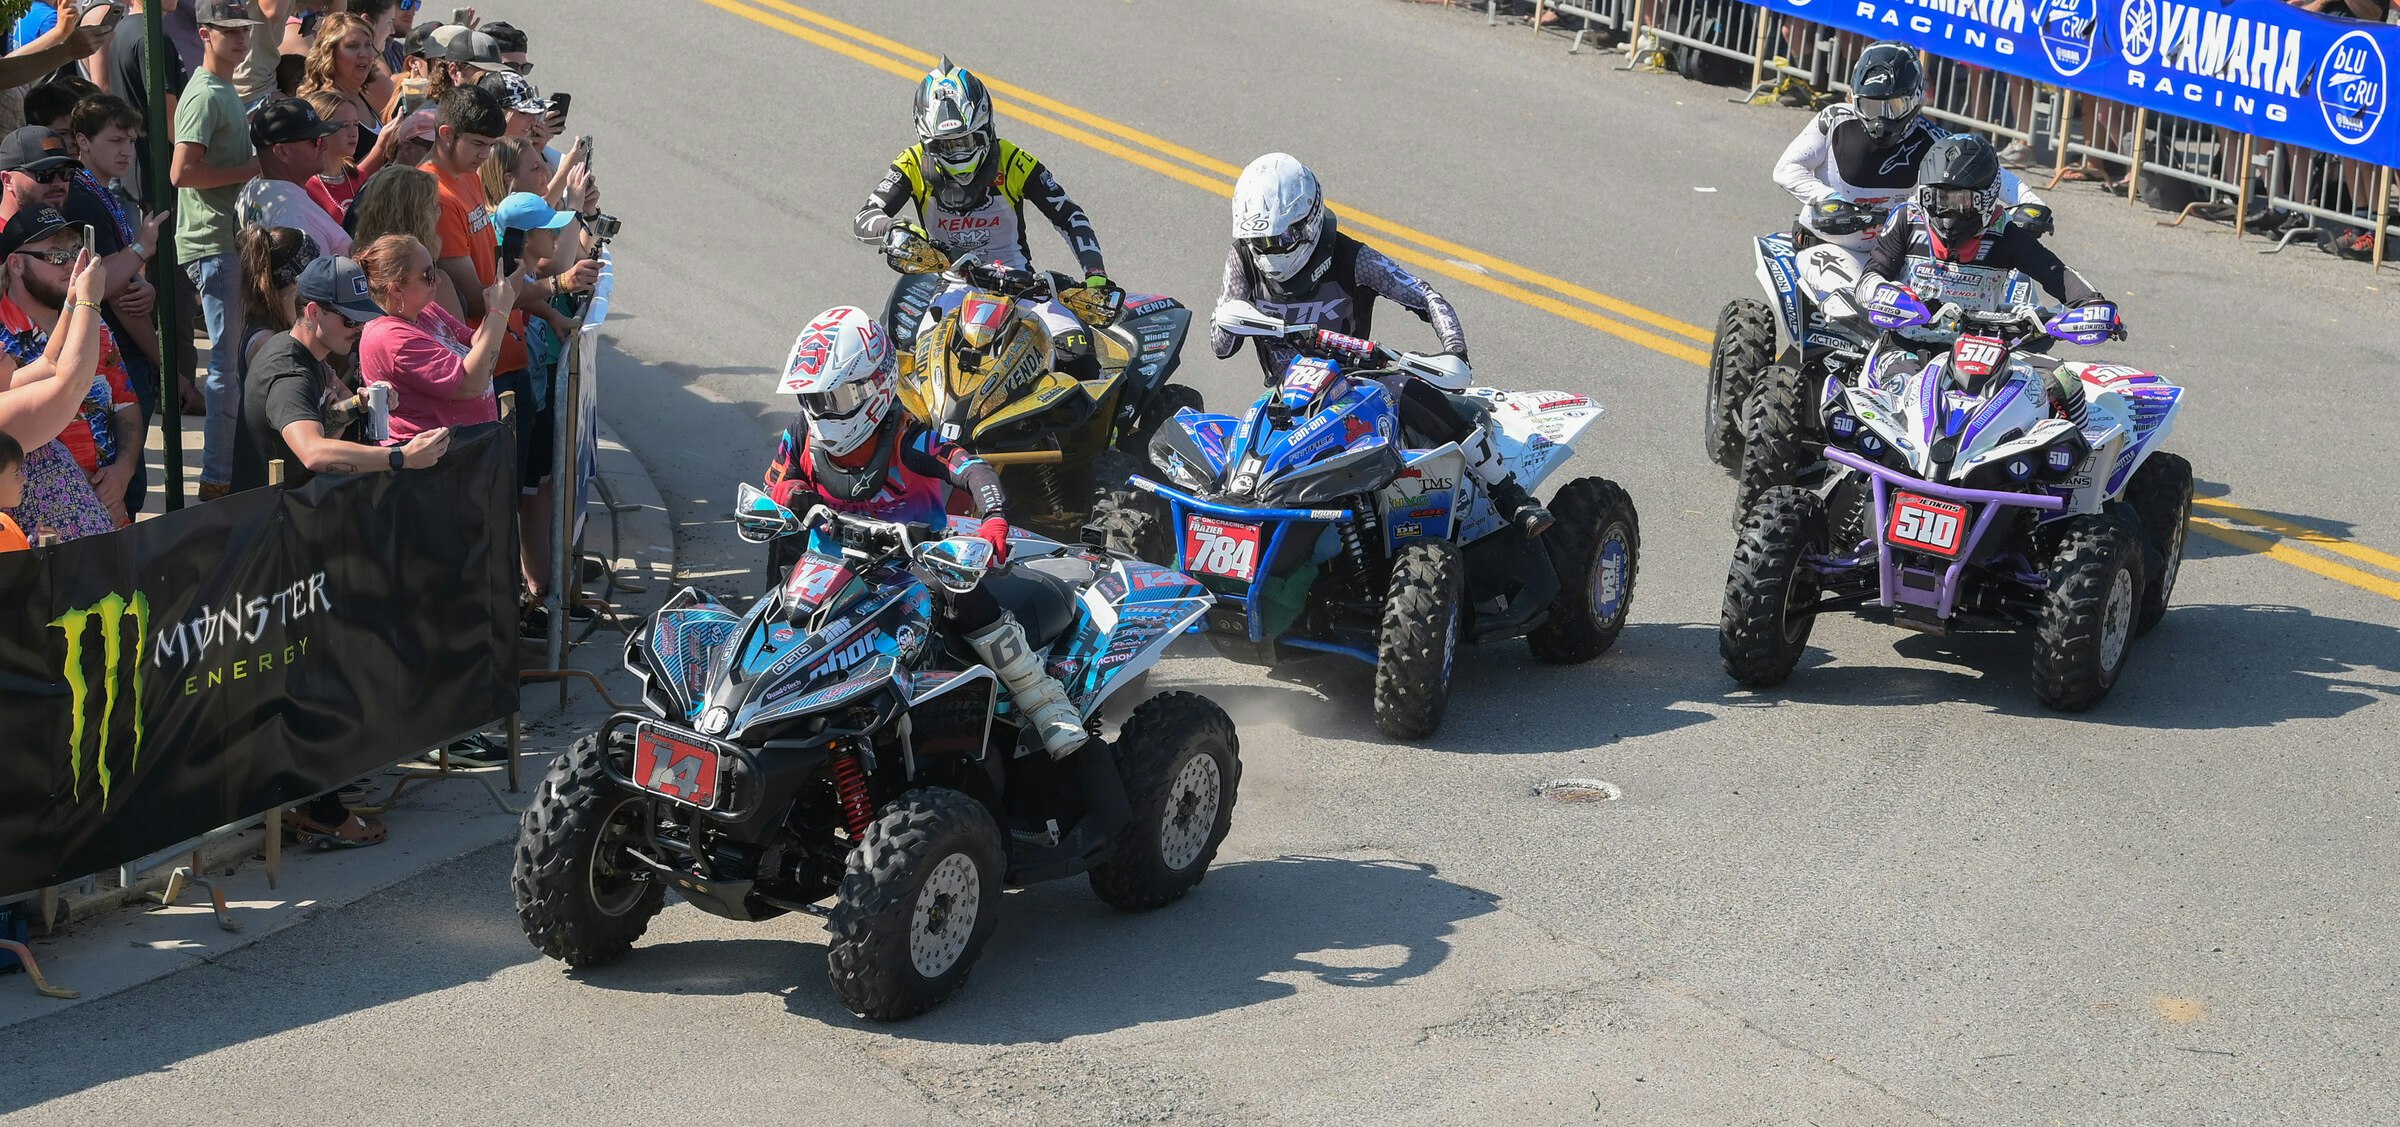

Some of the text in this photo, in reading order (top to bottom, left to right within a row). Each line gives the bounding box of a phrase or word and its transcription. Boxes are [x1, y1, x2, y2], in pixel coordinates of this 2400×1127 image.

[1856, 4, 2015, 55] RACING
[2159, 3, 2301, 98] YAMAHA
[2127, 69, 2288, 122] RACING
[937, 216, 1000, 231] KENDA
[1311, 257, 1333, 283] LEATT
[1916, 266, 1937, 277] FULL
[1945, 289, 1977, 298] KENDA
[970, 303, 997, 325] 1
[1135, 299, 1175, 316] KENDA
[2083, 306, 2111, 321] 510
[1957, 343, 2001, 366] 510
[1004, 346, 1044, 394] KENDA
[1284, 365, 1330, 390] 784
[1288, 415, 1327, 447] can-am
[1834, 416, 1854, 432] 510
[2049, 451, 2070, 466] 510
[1419, 477, 1453, 494] TMS
[1919, 498, 1960, 513] JENKINS
[1190, 521, 1223, 535] FRAZIER
[1896, 505, 1958, 549] 510
[804, 554, 842, 569] WHARFF
[1190, 533, 1255, 578] 784
[787, 563, 838, 598] 14
[1132, 573, 1187, 588] 14
[1601, 553, 1617, 605] 784
[154, 570, 331, 668] MONSTER
[185, 637, 308, 696] ENERGY
[771, 643, 813, 676] OGIO
[766, 679, 802, 701] Quad Tech
[647, 745, 704, 799] 14
